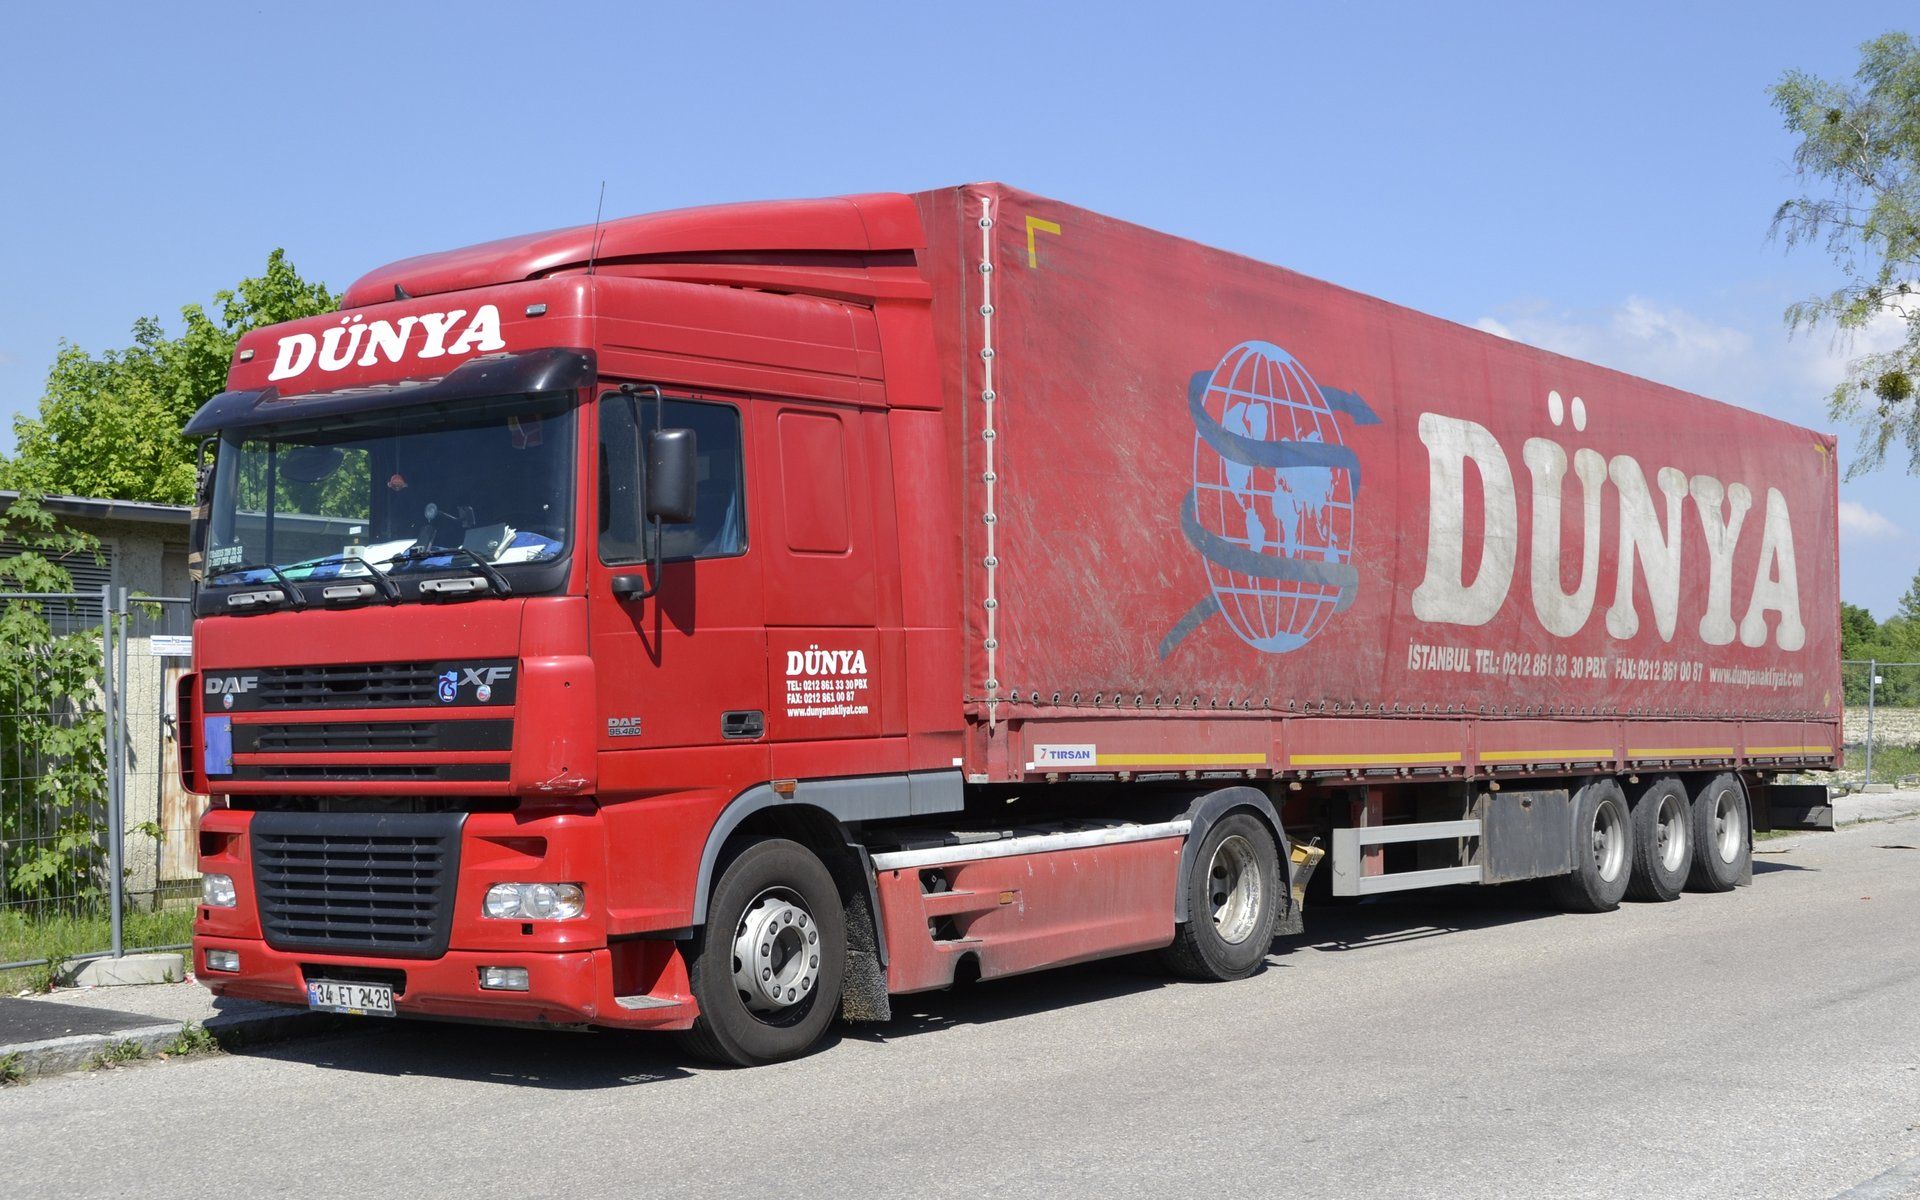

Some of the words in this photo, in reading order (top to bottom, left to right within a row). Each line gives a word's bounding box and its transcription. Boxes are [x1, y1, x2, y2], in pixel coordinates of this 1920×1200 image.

[268, 304, 506, 381] DÜNYA
[1412, 390, 1806, 651] DÜNYA
[786, 644, 867, 675] DÜNYA
[1476, 649, 1499, 674] TEL:
[1502, 652, 1530, 676] 0212
[1533, 653, 1551, 677] 861
[1555, 654, 1568, 677] 33
[1571, 657, 1583, 678] 30
[1586, 656, 1607, 678] PBX
[1615, 658, 1636, 679] FAX:
[1638, 660, 1660, 681] 0212
[1662, 661, 1677, 681] 861
[1680, 662, 1691, 682] 00
[1692, 663, 1703, 682] 87
[205, 677, 258, 694] DAF
[457, 667, 513, 686] XF
[786, 680, 802, 691] TEL:
[803, 680, 820, 690] 0212
[821, 680, 834, 690] 861
[835, 680, 844, 690] 33
[845, 680, 853, 690] 30
[854, 678, 867, 689] PBX
[787, 693, 803, 704] FAX:
[804, 693, 820, 704] 0212
[822, 692, 835, 702] 861
[836, 692, 845, 702] 00
[846, 691, 854, 701] 87
[787, 705, 868, 718] www.dunyanakliyat.com
[608, 717, 641, 726] DAF
[1050, 750, 1090, 759] TIRSAN
[318, 984, 333, 1003] 34
[339, 987, 352, 1005] ET
[359, 988, 390, 1009] 2429
